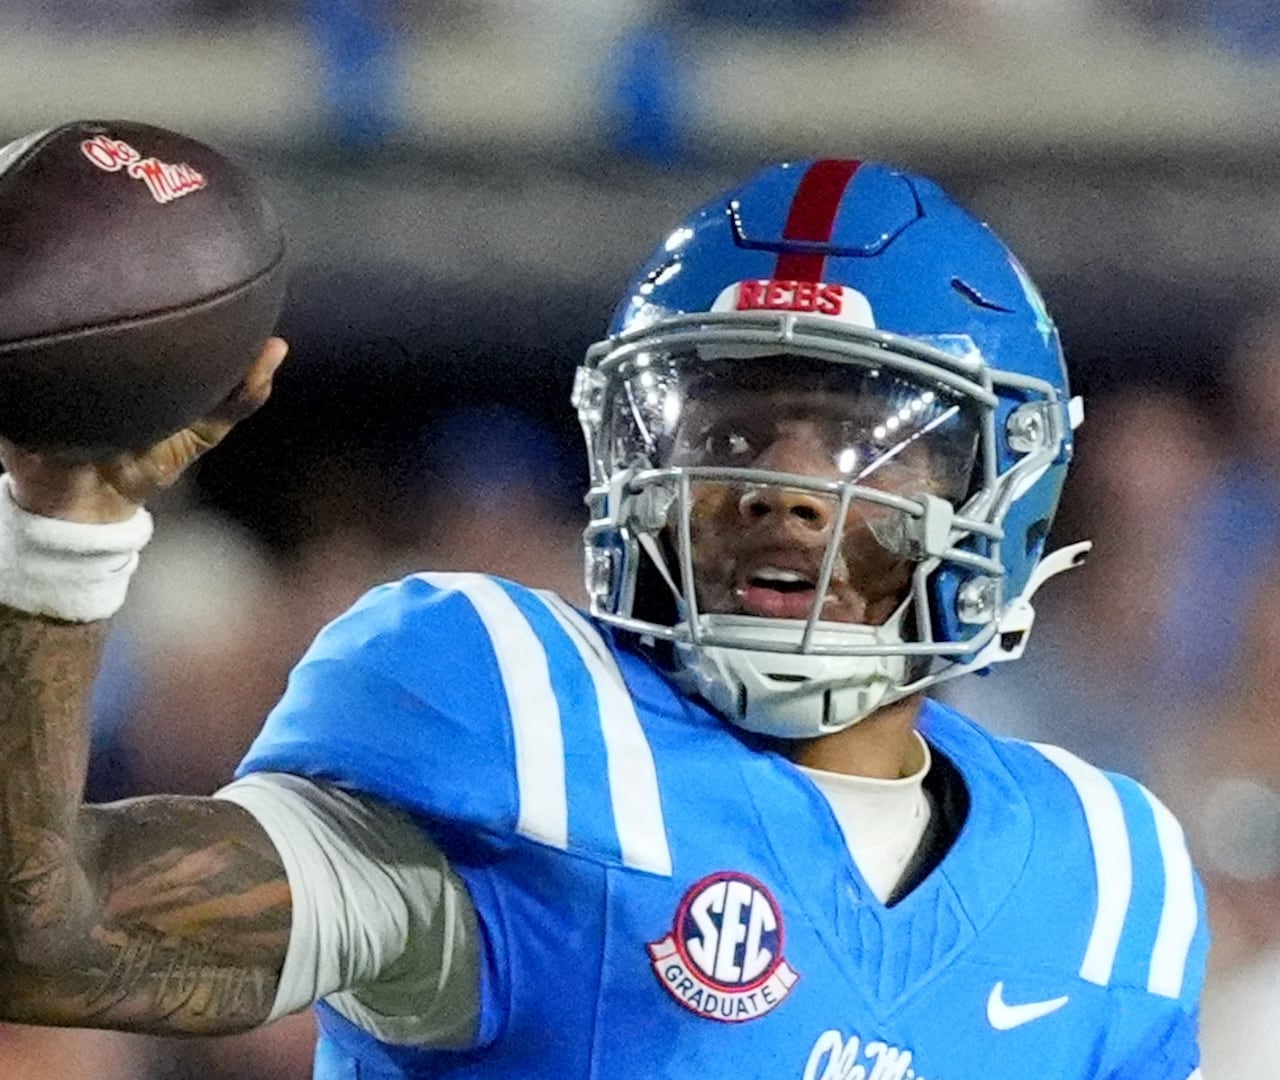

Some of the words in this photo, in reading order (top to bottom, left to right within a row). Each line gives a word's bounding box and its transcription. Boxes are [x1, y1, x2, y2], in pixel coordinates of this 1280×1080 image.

[81, 135, 141, 172] Ole
[127, 158, 207, 203] Miss
[736, 280, 843, 315] REBS
[686, 881, 777, 983] SEC
[664, 963, 777, 1017] GRADUATE
